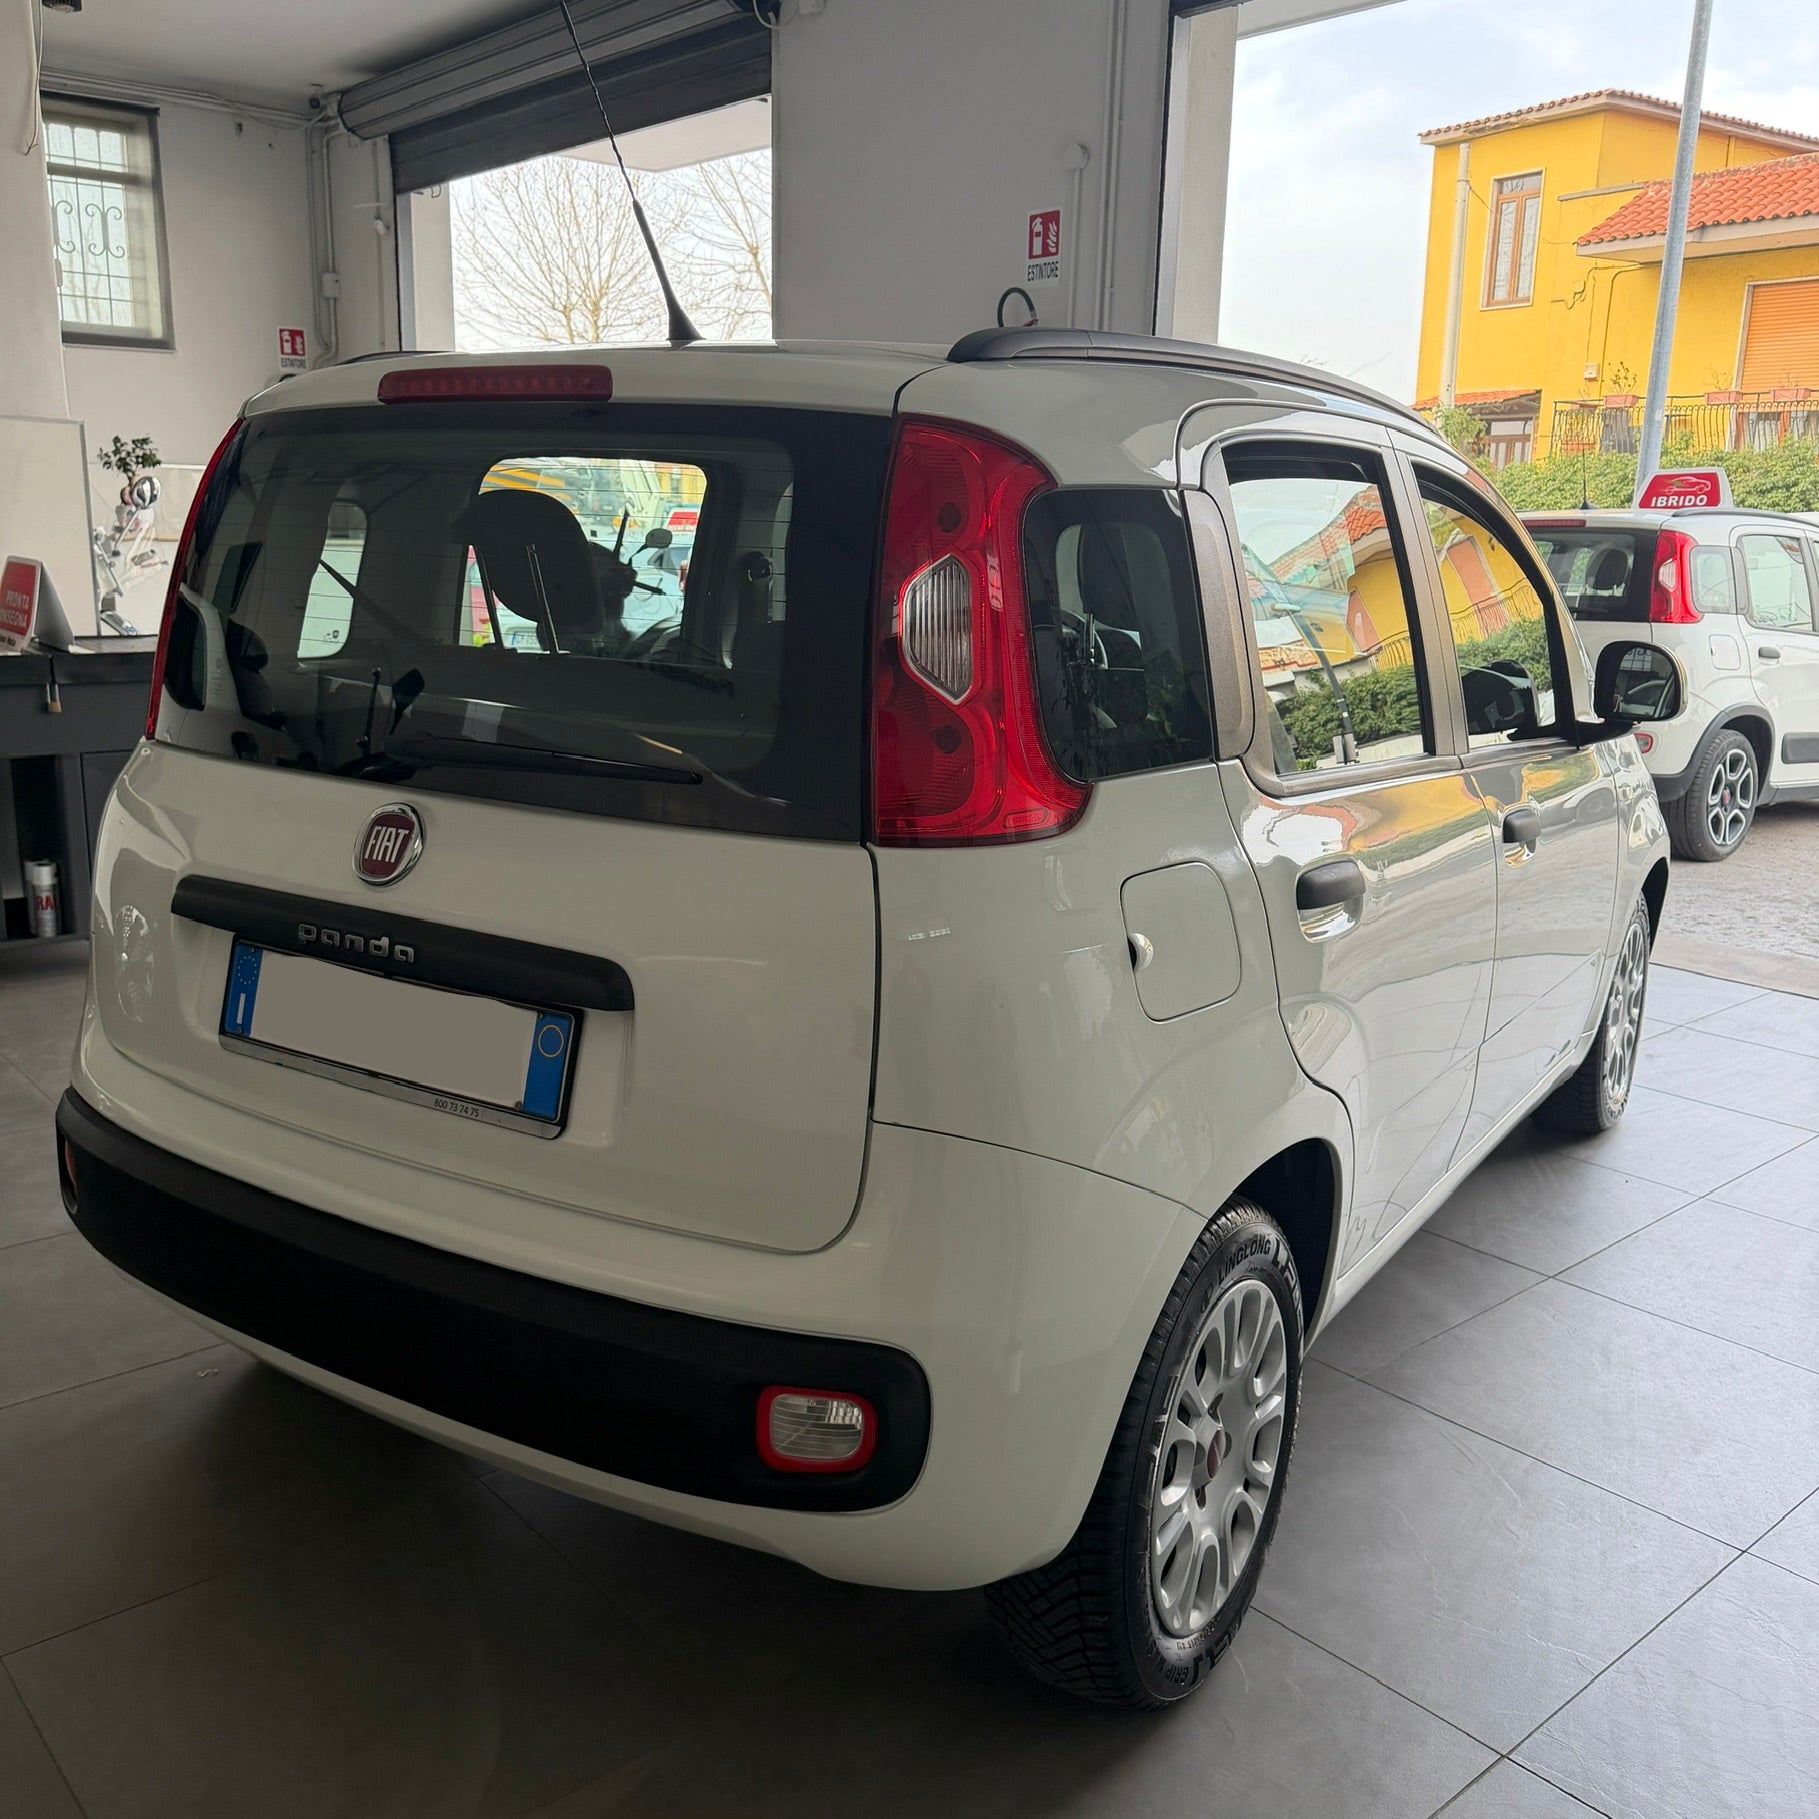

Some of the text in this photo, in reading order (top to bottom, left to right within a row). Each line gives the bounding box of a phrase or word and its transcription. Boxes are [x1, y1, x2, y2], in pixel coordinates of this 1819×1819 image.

[1027, 261, 1059, 281] ESTINTORE
[1650, 495, 1708, 507] IBRIDO
[0, 607, 28, 629] ONSEGNA
[364, 825, 410, 863] FIAT
[298, 923, 415, 963] panda
[433, 1098, 480, 1118] 800 73 74 75
[1218, 1235, 1272, 1286] LINGLONG
